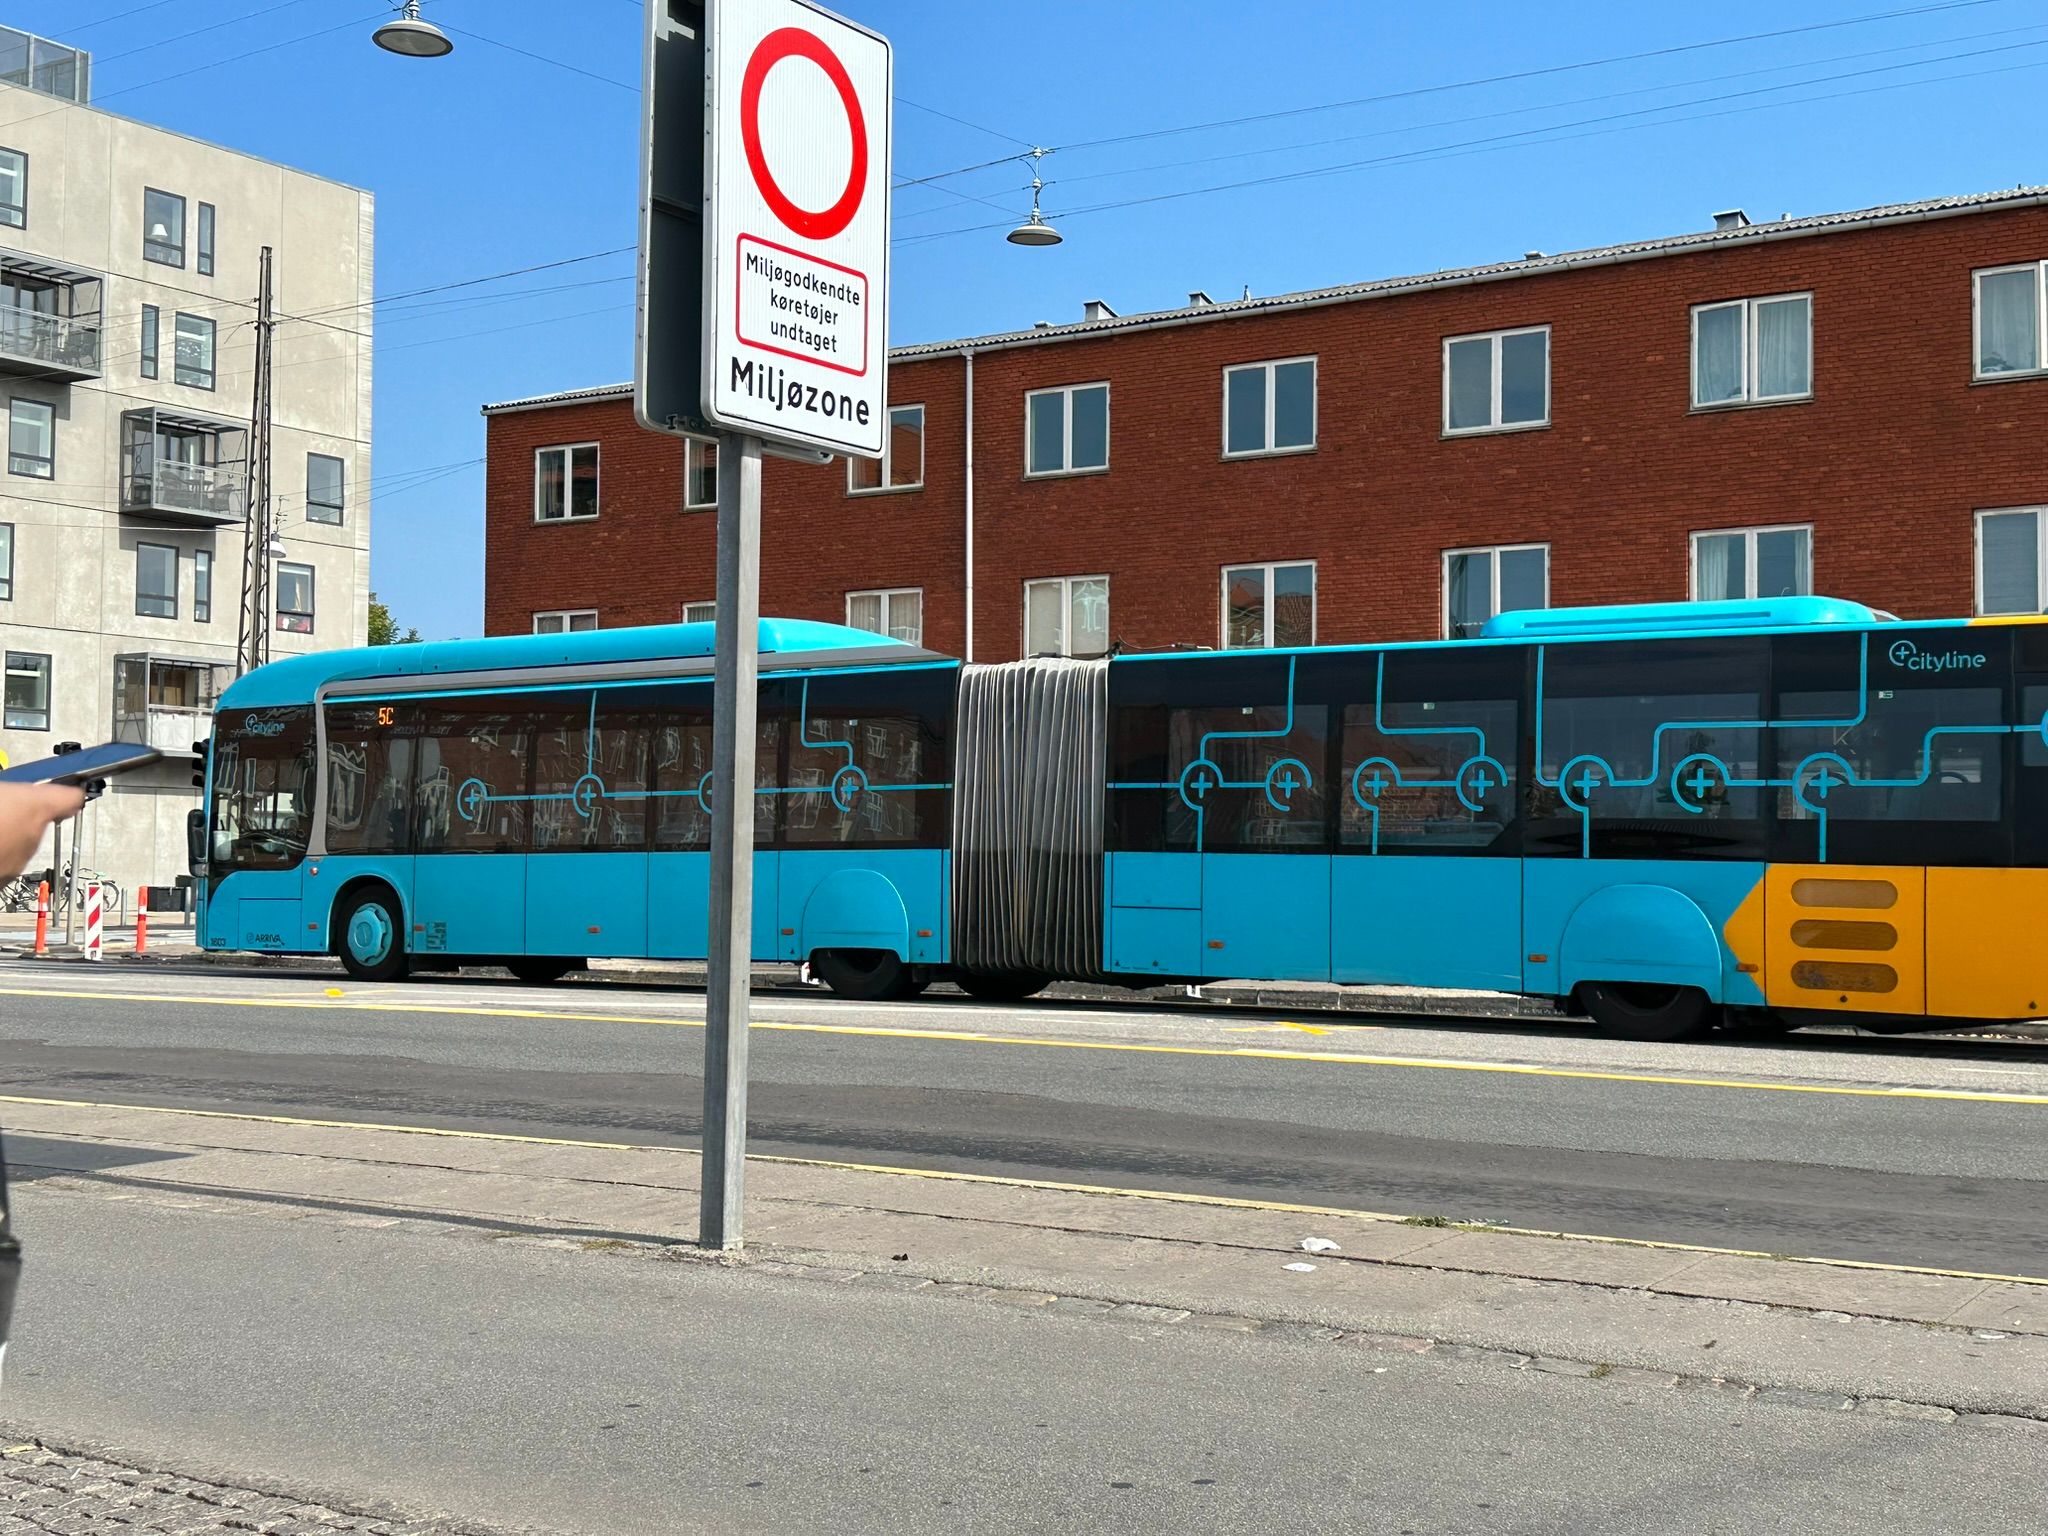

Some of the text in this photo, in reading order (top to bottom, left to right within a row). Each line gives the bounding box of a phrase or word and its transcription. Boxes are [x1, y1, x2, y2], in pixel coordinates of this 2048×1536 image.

[746, 252, 860, 305] Miljøgodkendte
[770, 288, 839, 326] køretøjer
[770, 320, 837, 353] undtaget
[731, 356, 870, 426] Miljøzone
[1907, 651, 1986, 672] cityline
[377, 706, 395, 726] 5C
